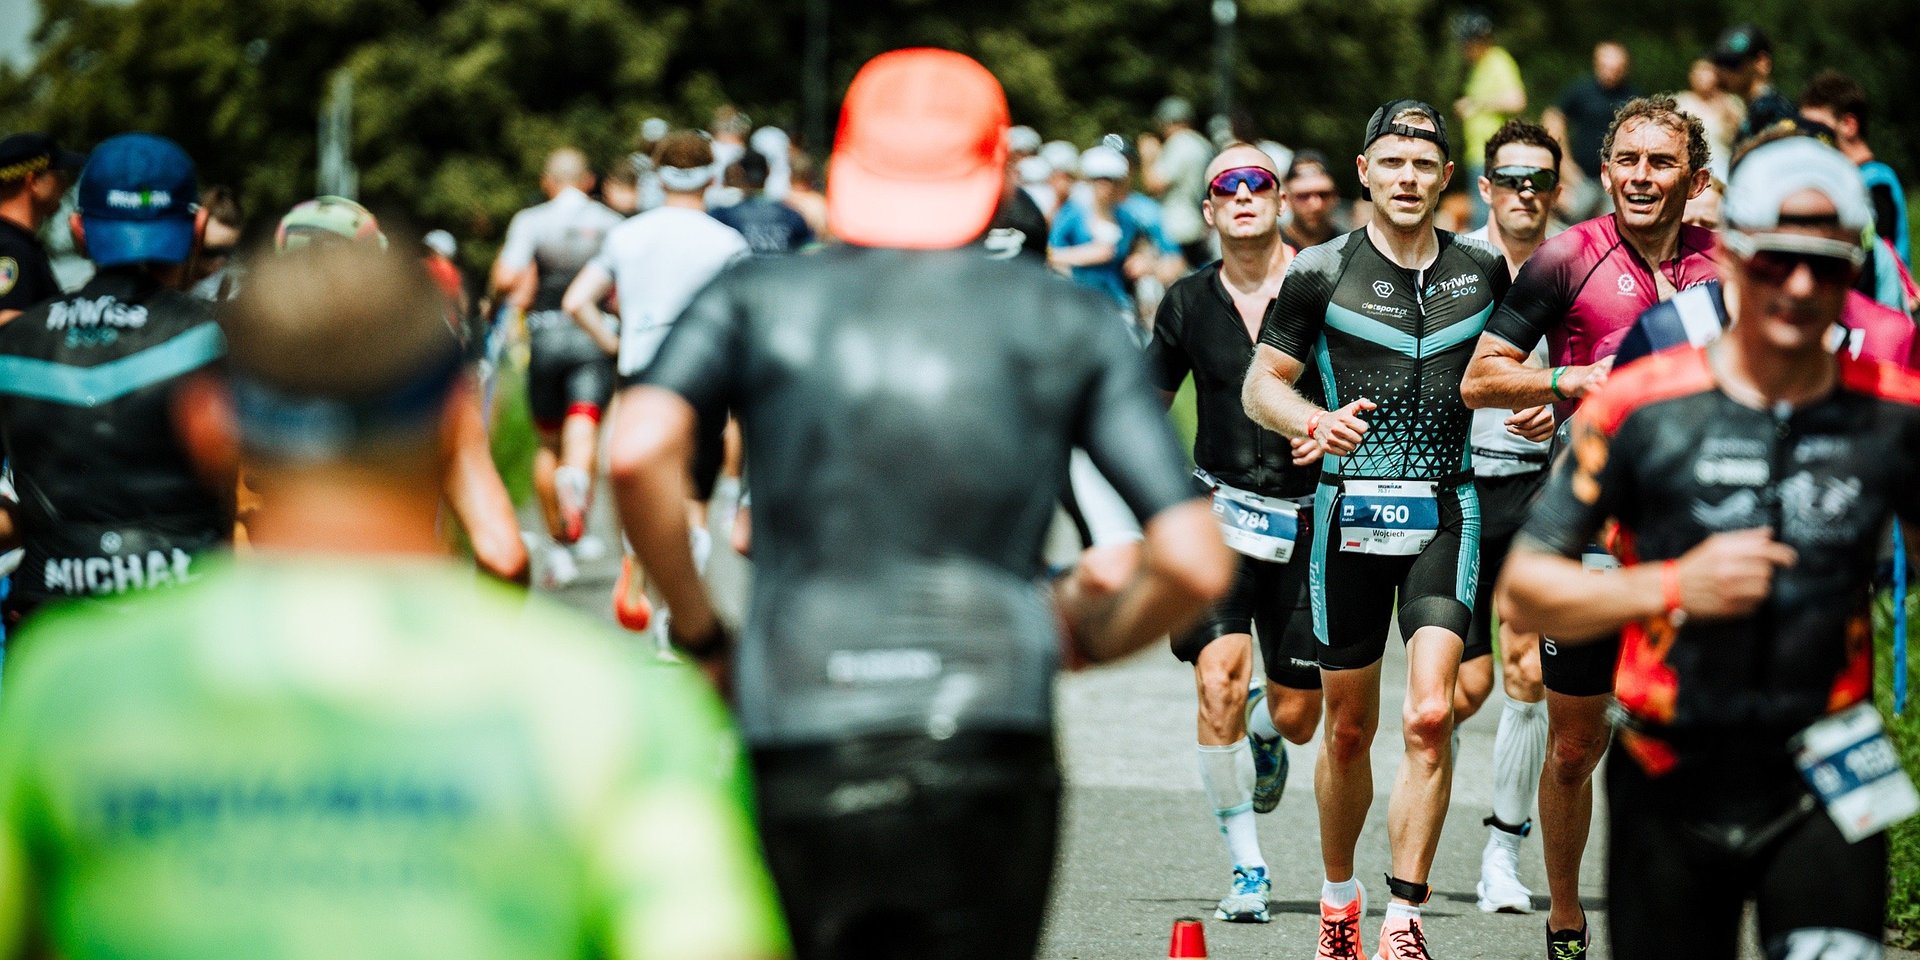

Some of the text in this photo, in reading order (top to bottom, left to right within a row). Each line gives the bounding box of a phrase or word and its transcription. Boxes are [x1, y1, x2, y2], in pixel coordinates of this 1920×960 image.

[1440, 273, 1479, 291] TriWise
[1237, 508, 1269, 531] 784
[1370, 504, 1410, 524] 760
[1372, 529, 1405, 538] Wojciech
[1309, 561, 1321, 629] TriWise
